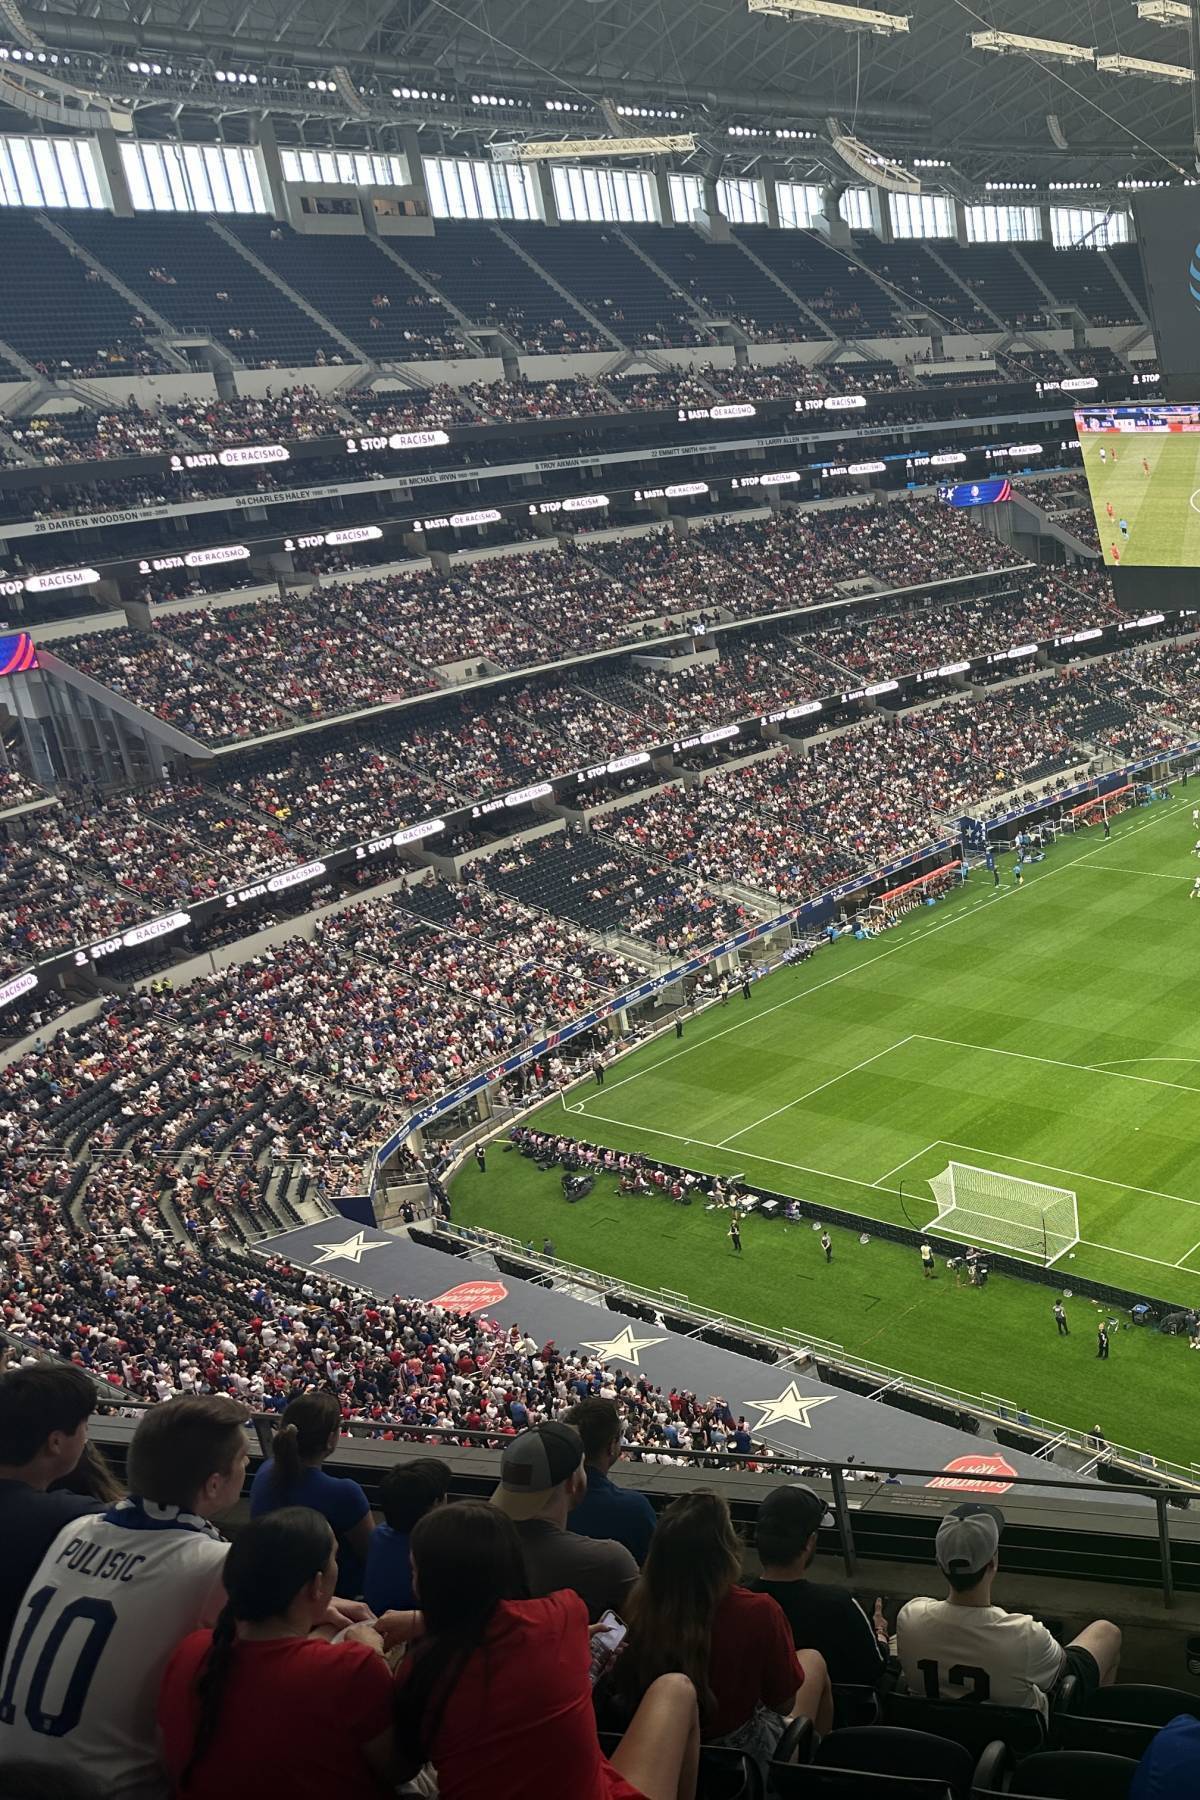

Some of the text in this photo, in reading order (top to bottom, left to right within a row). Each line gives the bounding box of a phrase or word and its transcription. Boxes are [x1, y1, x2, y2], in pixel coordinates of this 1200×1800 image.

[1141, 374, 1160, 383] STOP
[687, 406, 751, 419] BASTA DE RACISMO
[805, 398, 857, 410] STOP RACISM
[361, 433, 435, 450] STOP RACISM
[1068, 441, 1081, 449] STO
[184, 448, 284, 468] BASTA DE RACISMO
[914, 458, 930, 466] STOP
[408, 475, 438, 486] MICHAEL
[438, 472, 457, 483] IRVIN
[741, 474, 792, 486] STOP RACISM
[830, 467, 848, 476] BASTA
[236, 490, 310, 507] 94 CHARLES HALEY
[644, 485, 705, 499] BASTA RACISMO
[540, 498, 599, 513] STOP RACISM
[34, 512, 139, 532] 28 DARREN WOODSON
[424, 512, 497, 530] BASTA DE RACISMO
[298, 529, 369, 548] STOP RACISM
[152, 548, 245, 570] BASTA DE RACISMO
[0, 573, 84, 595] TOP RACISM
[923, 670, 938, 680] STOP
[769, 704, 814, 723] STOP RACISM
[681, 727, 736, 749] BASTA RACISMO
[587, 756, 641, 779] STOP RACISM
[482, 785, 548, 814] BASTA DE RACISMO
[368, 824, 434, 853] STOP RACISM
[239, 864, 322, 901] BASTA DE RACISMO
[90, 918, 175, 959] STOP RACISM
[0, 975, 34, 1001] RACISMO
[956, 1463, 1002, 1475] ARMY
[55, 1538, 146, 1582] PULISIC
[0, 1585, 118, 1738] 10
